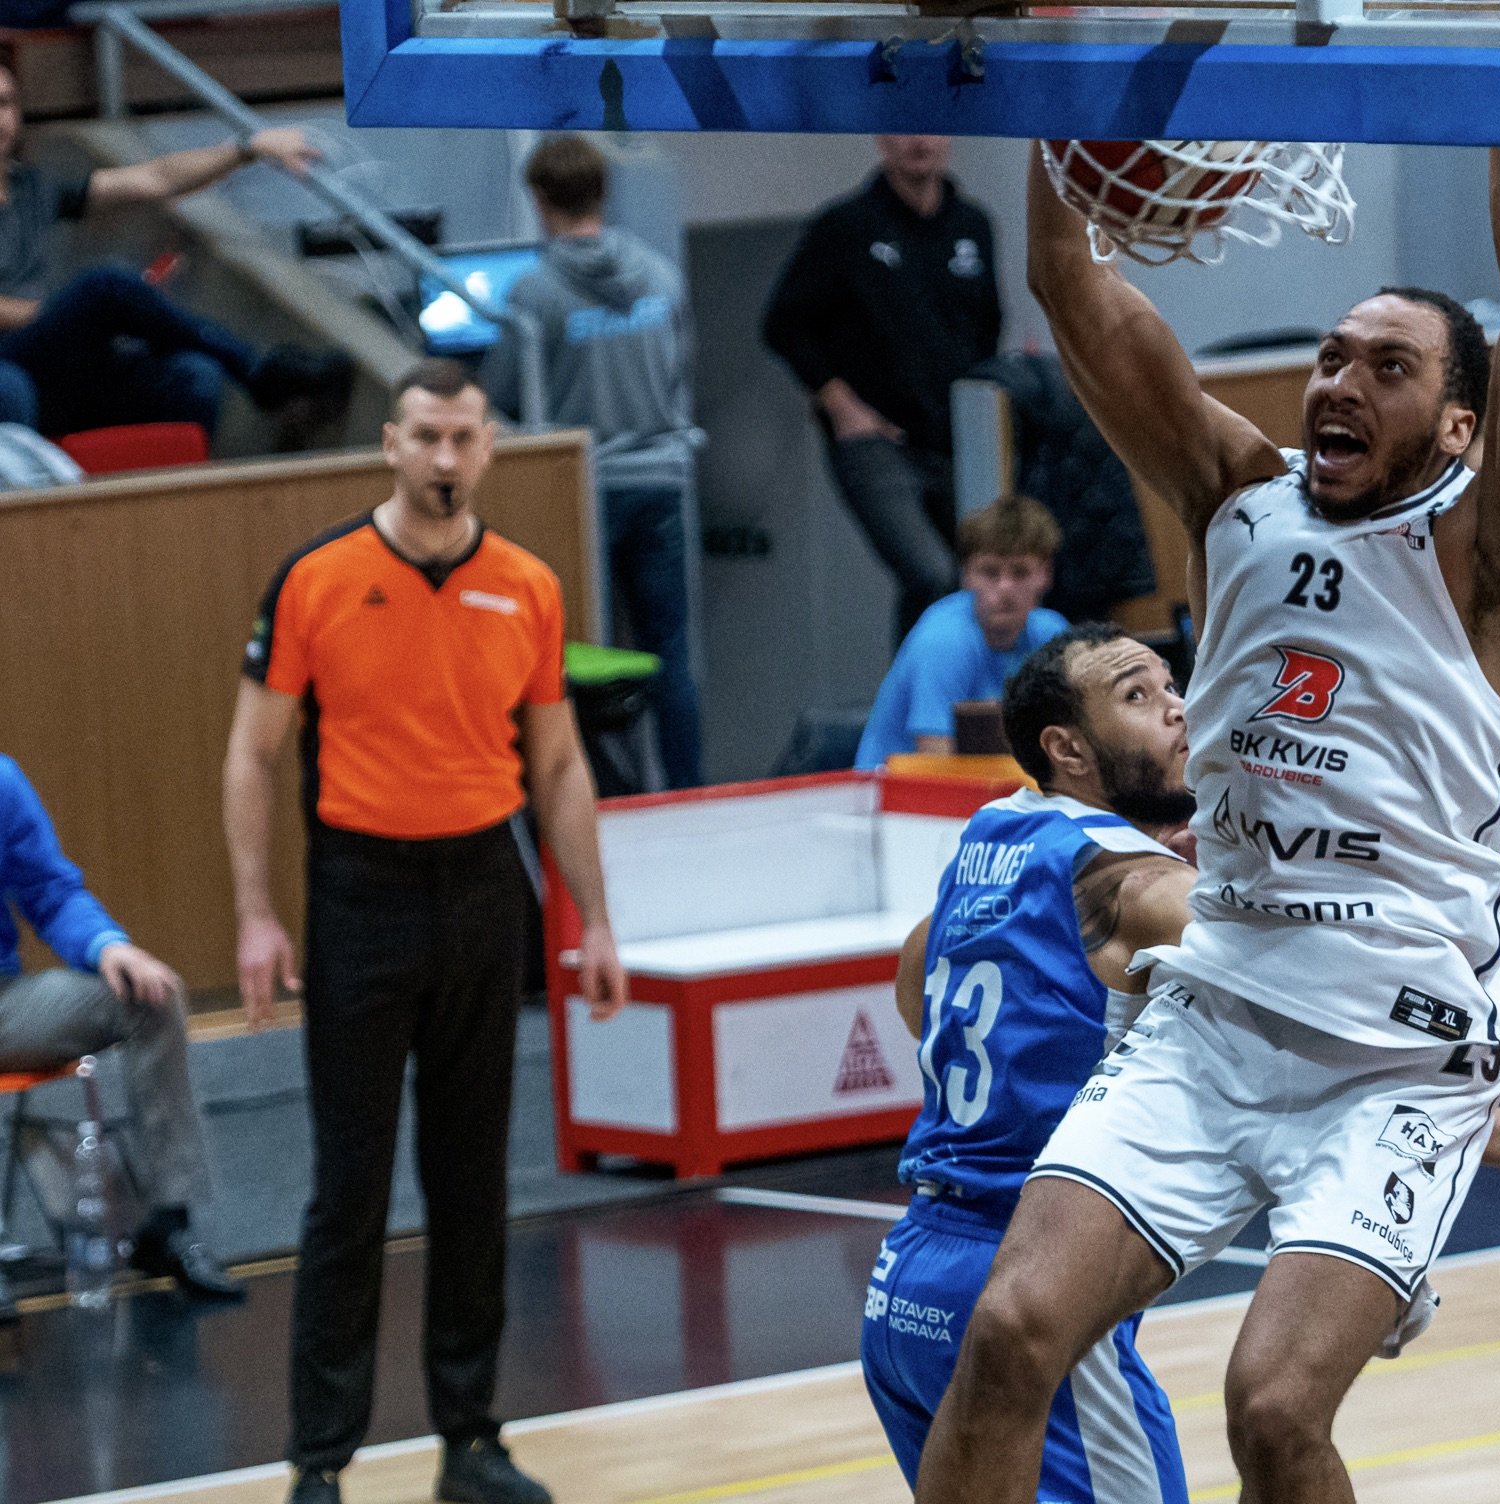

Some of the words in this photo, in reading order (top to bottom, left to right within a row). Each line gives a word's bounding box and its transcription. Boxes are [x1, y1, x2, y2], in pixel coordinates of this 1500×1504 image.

[1283, 551, 1344, 613] 23
[1230, 729, 1268, 759] BK
[1268, 739, 1348, 772] KVIS
[955, 841, 1035, 886] HOLME
[1440, 1008, 1457, 1027] XL
[920, 956, 1003, 1127] 13
[1400, 1121, 1444, 1154] HAK
[1350, 1210, 1414, 1264] Pardubice
[888, 1314, 953, 1344] MORAVA
[890, 1296, 955, 1326] STAVBY
